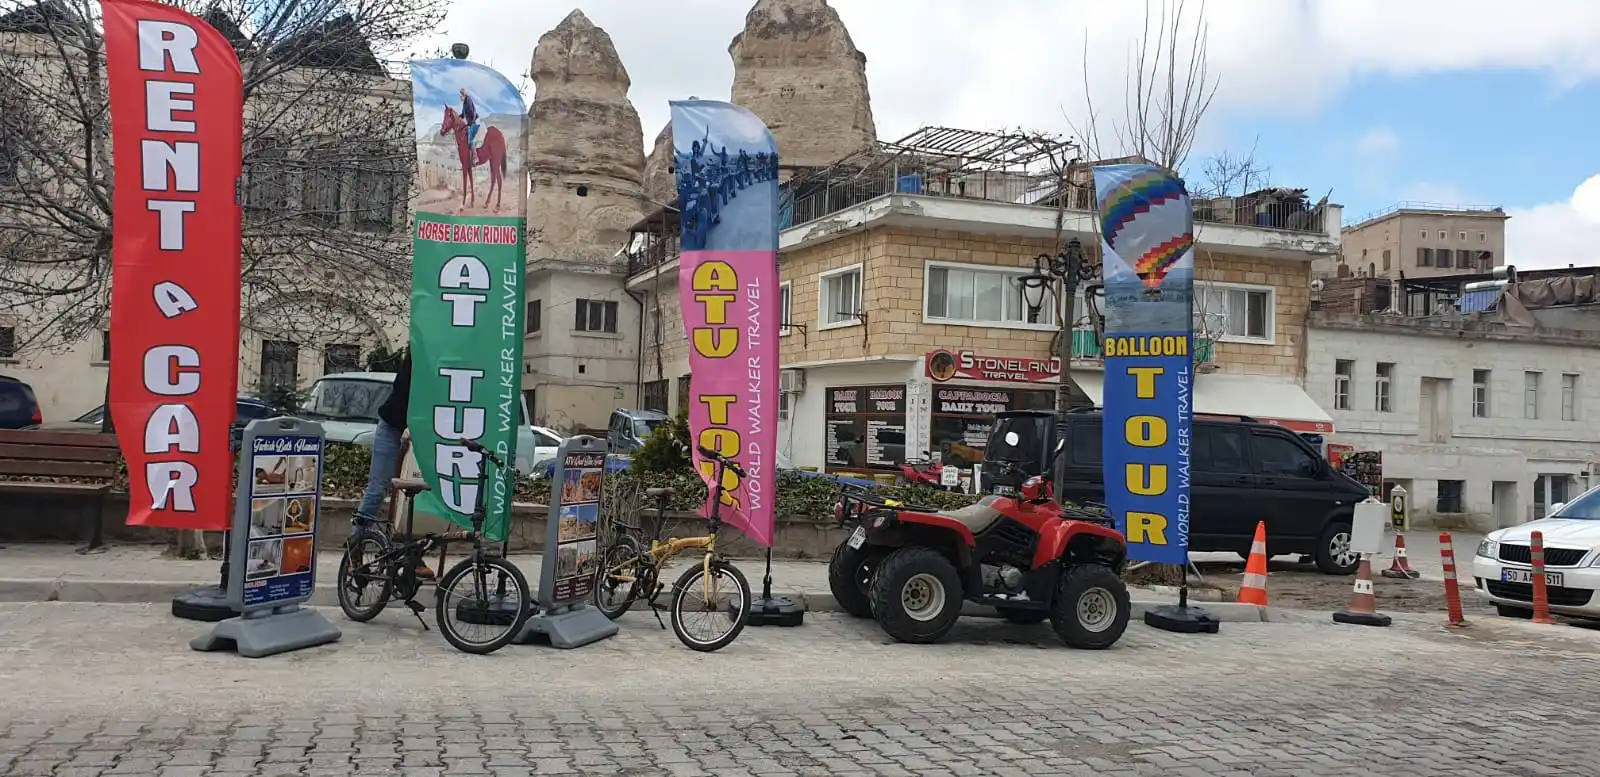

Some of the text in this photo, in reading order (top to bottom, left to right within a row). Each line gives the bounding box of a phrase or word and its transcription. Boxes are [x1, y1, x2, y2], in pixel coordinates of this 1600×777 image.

[137, 19, 200, 514] RENT A CAR
[417, 220, 518, 245] HORSE BACK RIDING
[433, 255, 491, 516] AT TURU
[493, 261, 518, 515] WORLD WALKER TRAVEL
[692, 260, 742, 512] ATV TOU
[748, 277, 761, 510] WORLD WALKER TRAVEL
[939, 390, 1009, 402] CAPPADOCIA
[960, 351, 1061, 374] STONELAND
[983, 370, 1029, 380] TRAVEL
[1105, 335, 1189, 357] BALLOON
[941, 402, 1005, 413] DAILY TOUR
[1125, 366, 1168, 546] TOUR
[1177, 366, 1190, 547] WORLD WALKER TRAVEL
[1507, 571, 1518, 581] 50
[1546, 575, 1560, 585] 511
